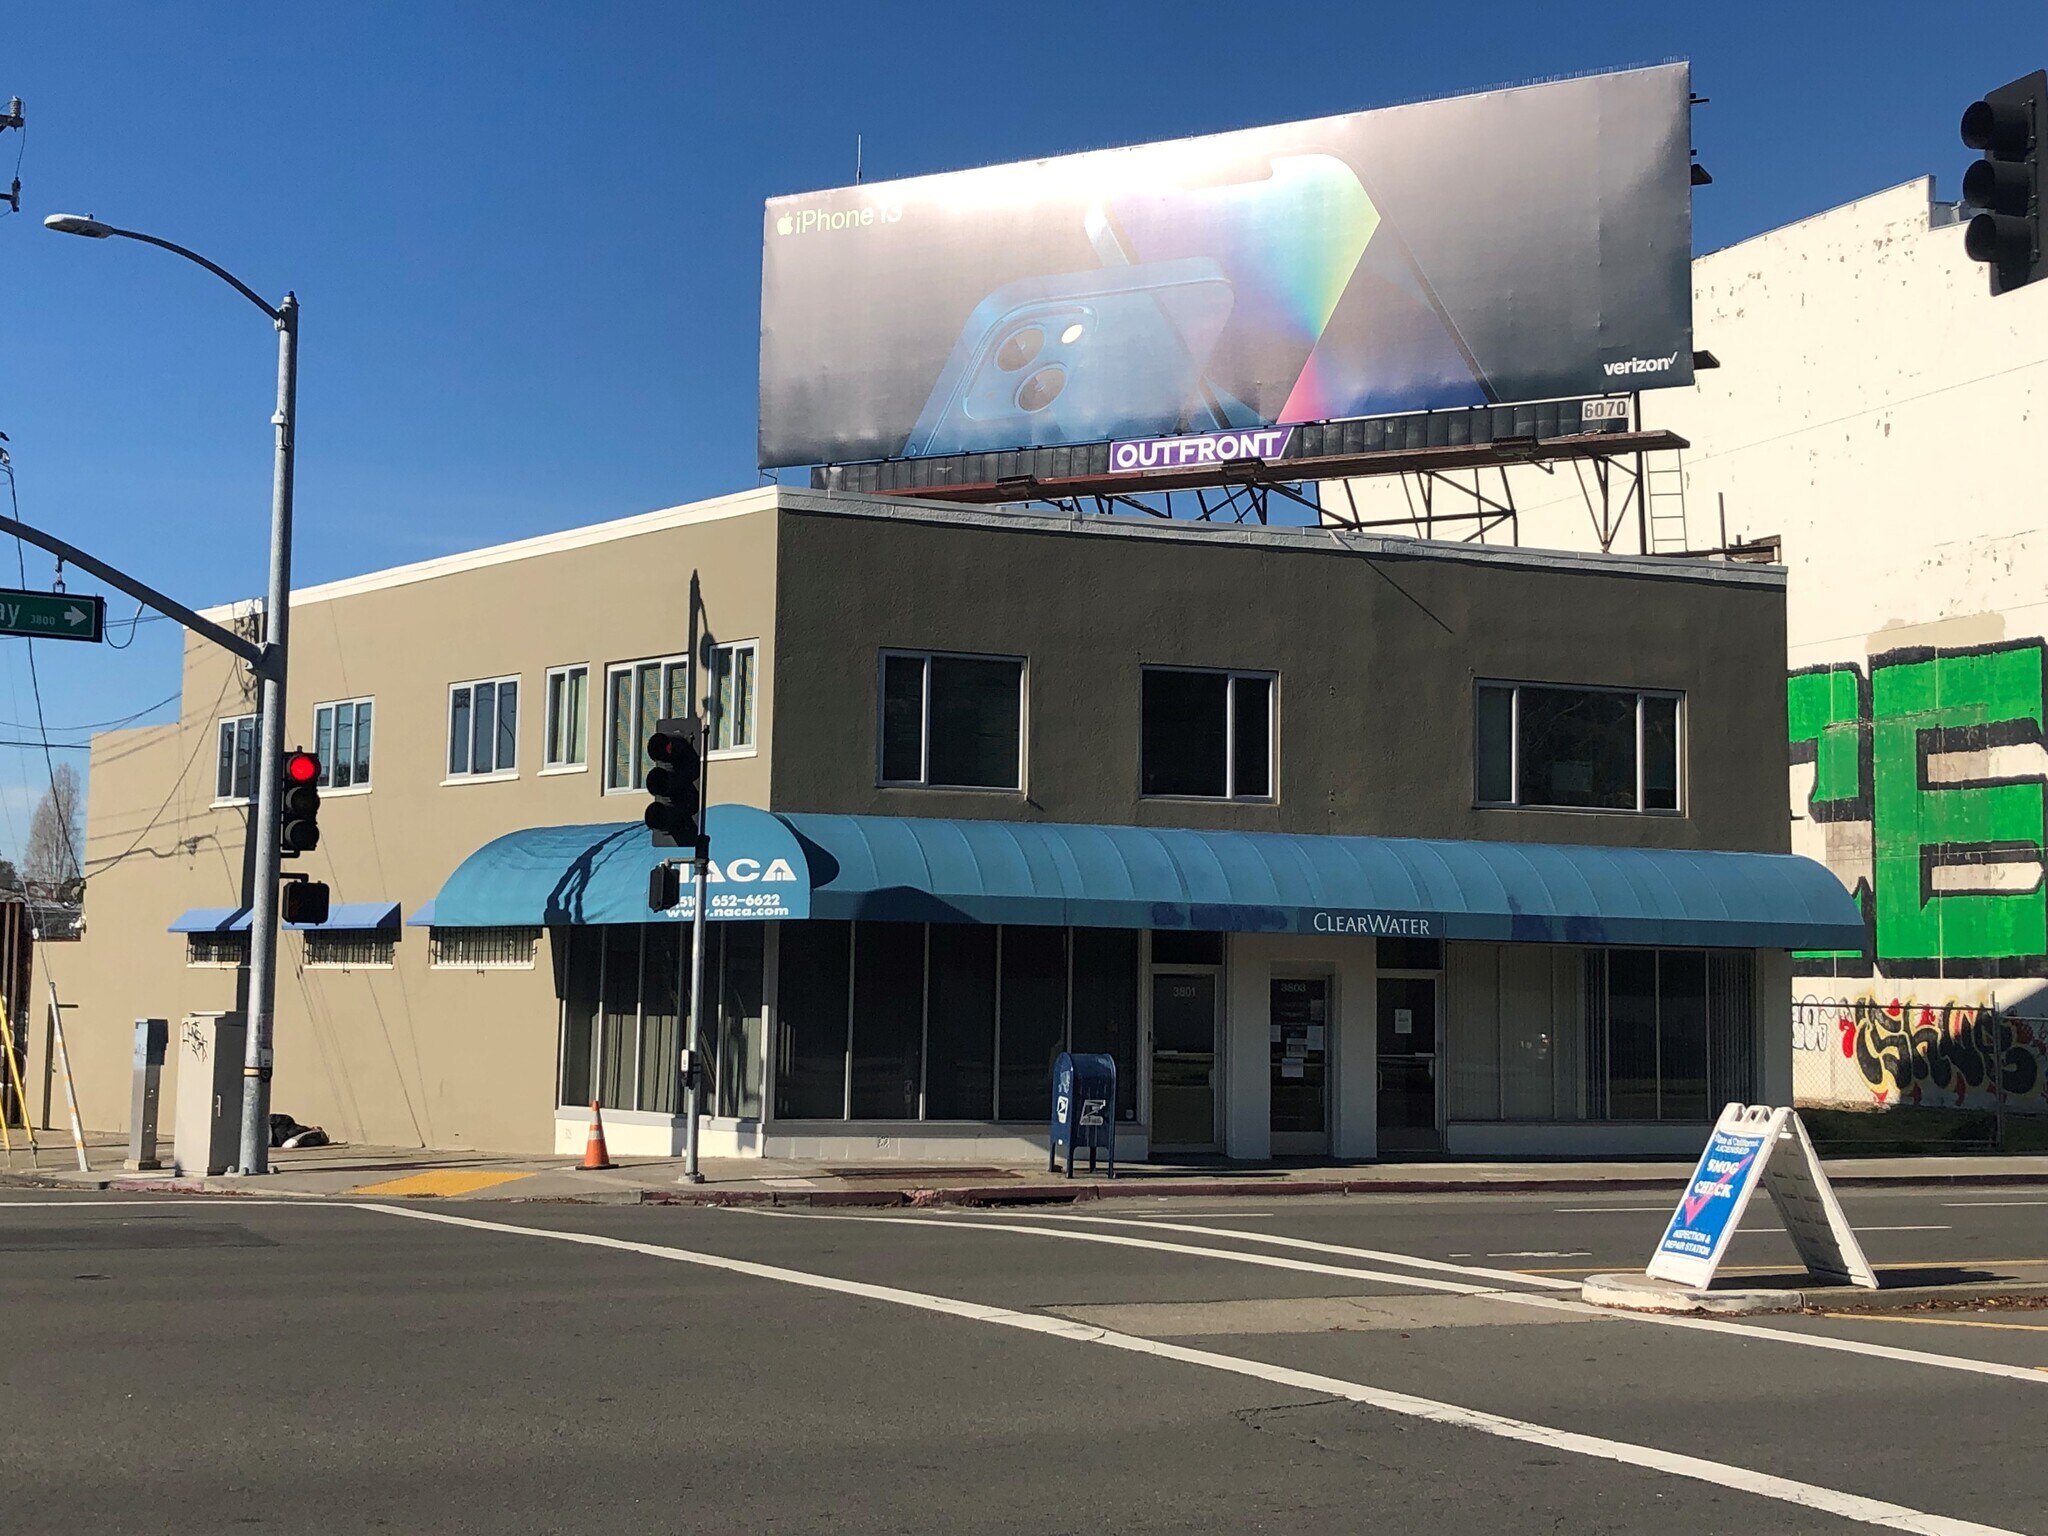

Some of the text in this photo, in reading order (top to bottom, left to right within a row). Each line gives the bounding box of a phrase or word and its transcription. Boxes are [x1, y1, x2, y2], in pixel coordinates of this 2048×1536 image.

[796, 207, 874, 234] iPhone
[1603, 357, 1669, 376] verizon
[1584, 400, 1626, 418] 6070
[1117, 431, 1282, 467] OUTFRONT
[31, 614, 55, 625] 3800
[711, 894, 781, 907] 652-6622
[666, 906, 789, 918] ww.naca.com
[1173, 986, 1196, 997] 3801
[1706, 1159, 1739, 1175] SMOG
[1694, 1180, 1734, 1198] CHECK
